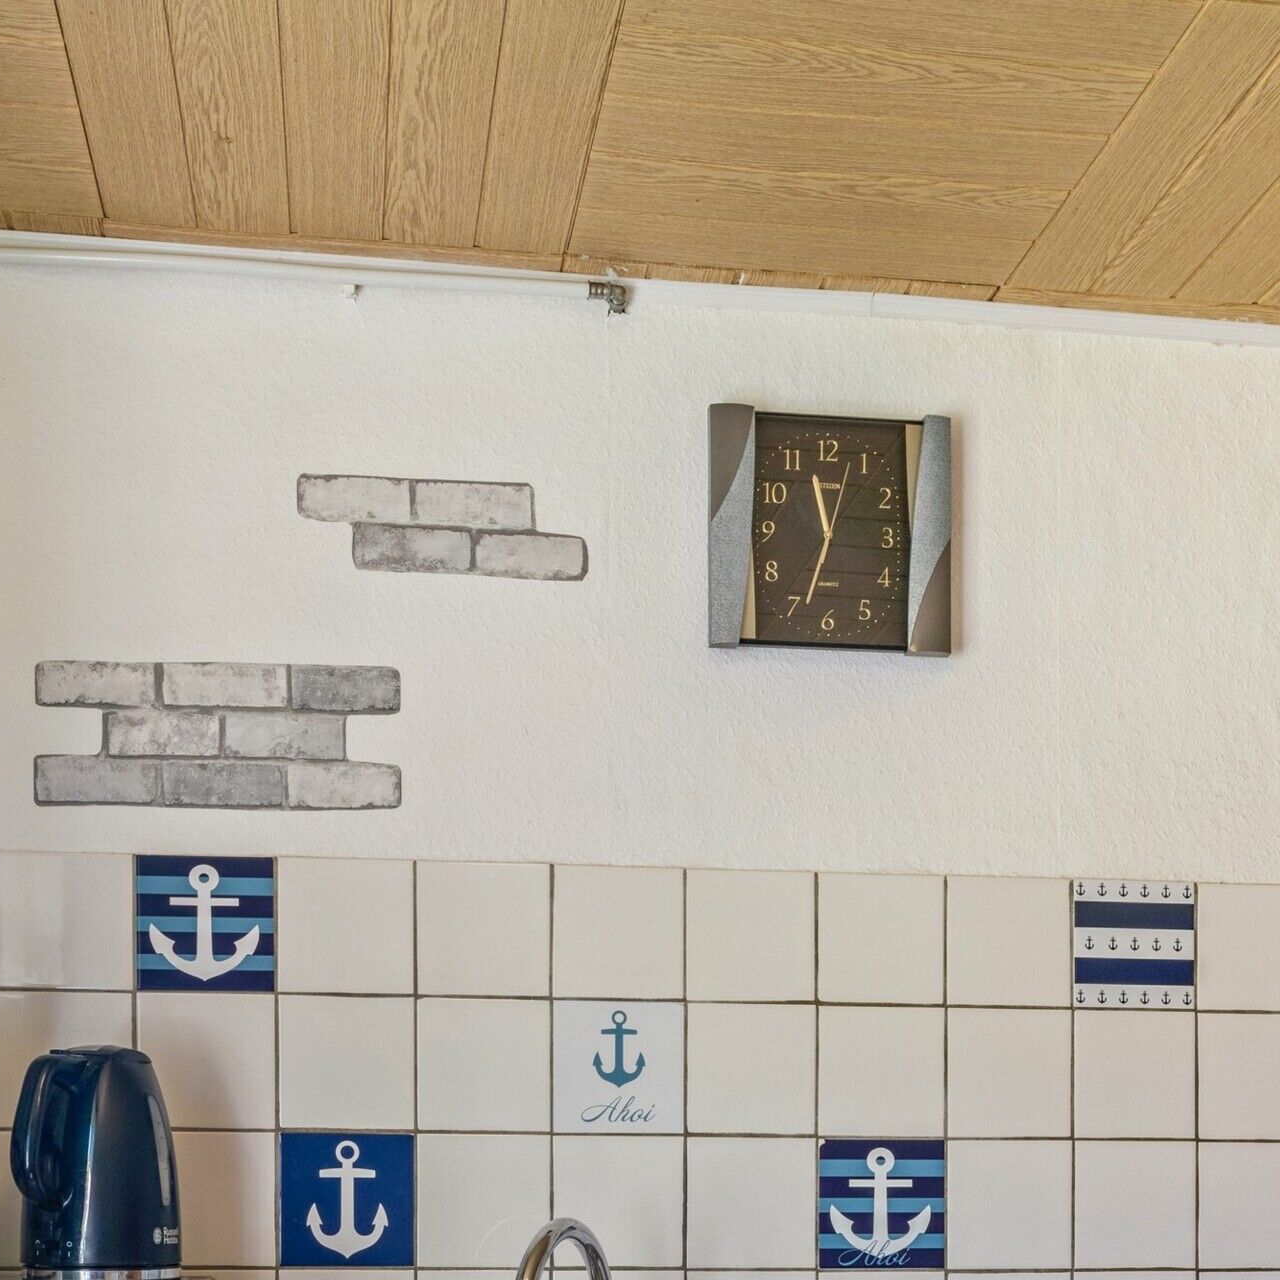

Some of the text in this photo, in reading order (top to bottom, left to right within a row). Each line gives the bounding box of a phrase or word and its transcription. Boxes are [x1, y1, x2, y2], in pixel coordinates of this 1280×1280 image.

[783, 449, 801, 471] 11
[817, 440, 838, 462] 12
[859, 453, 868, 475] 1
[762, 482, 787, 504] 10
[878, 487, 892, 509] 2
[762, 520, 776, 543] 9
[881, 527, 894, 549] 3
[764, 560, 778, 582] 8
[877, 566, 892, 588] 4
[786, 596, 801, 617] 7
[858, 599, 871, 621] 5
[820, 608, 835, 630] 6
[580, 1095, 656, 1123] Ahoi
[837, 1239, 911, 1267] Ahoi
